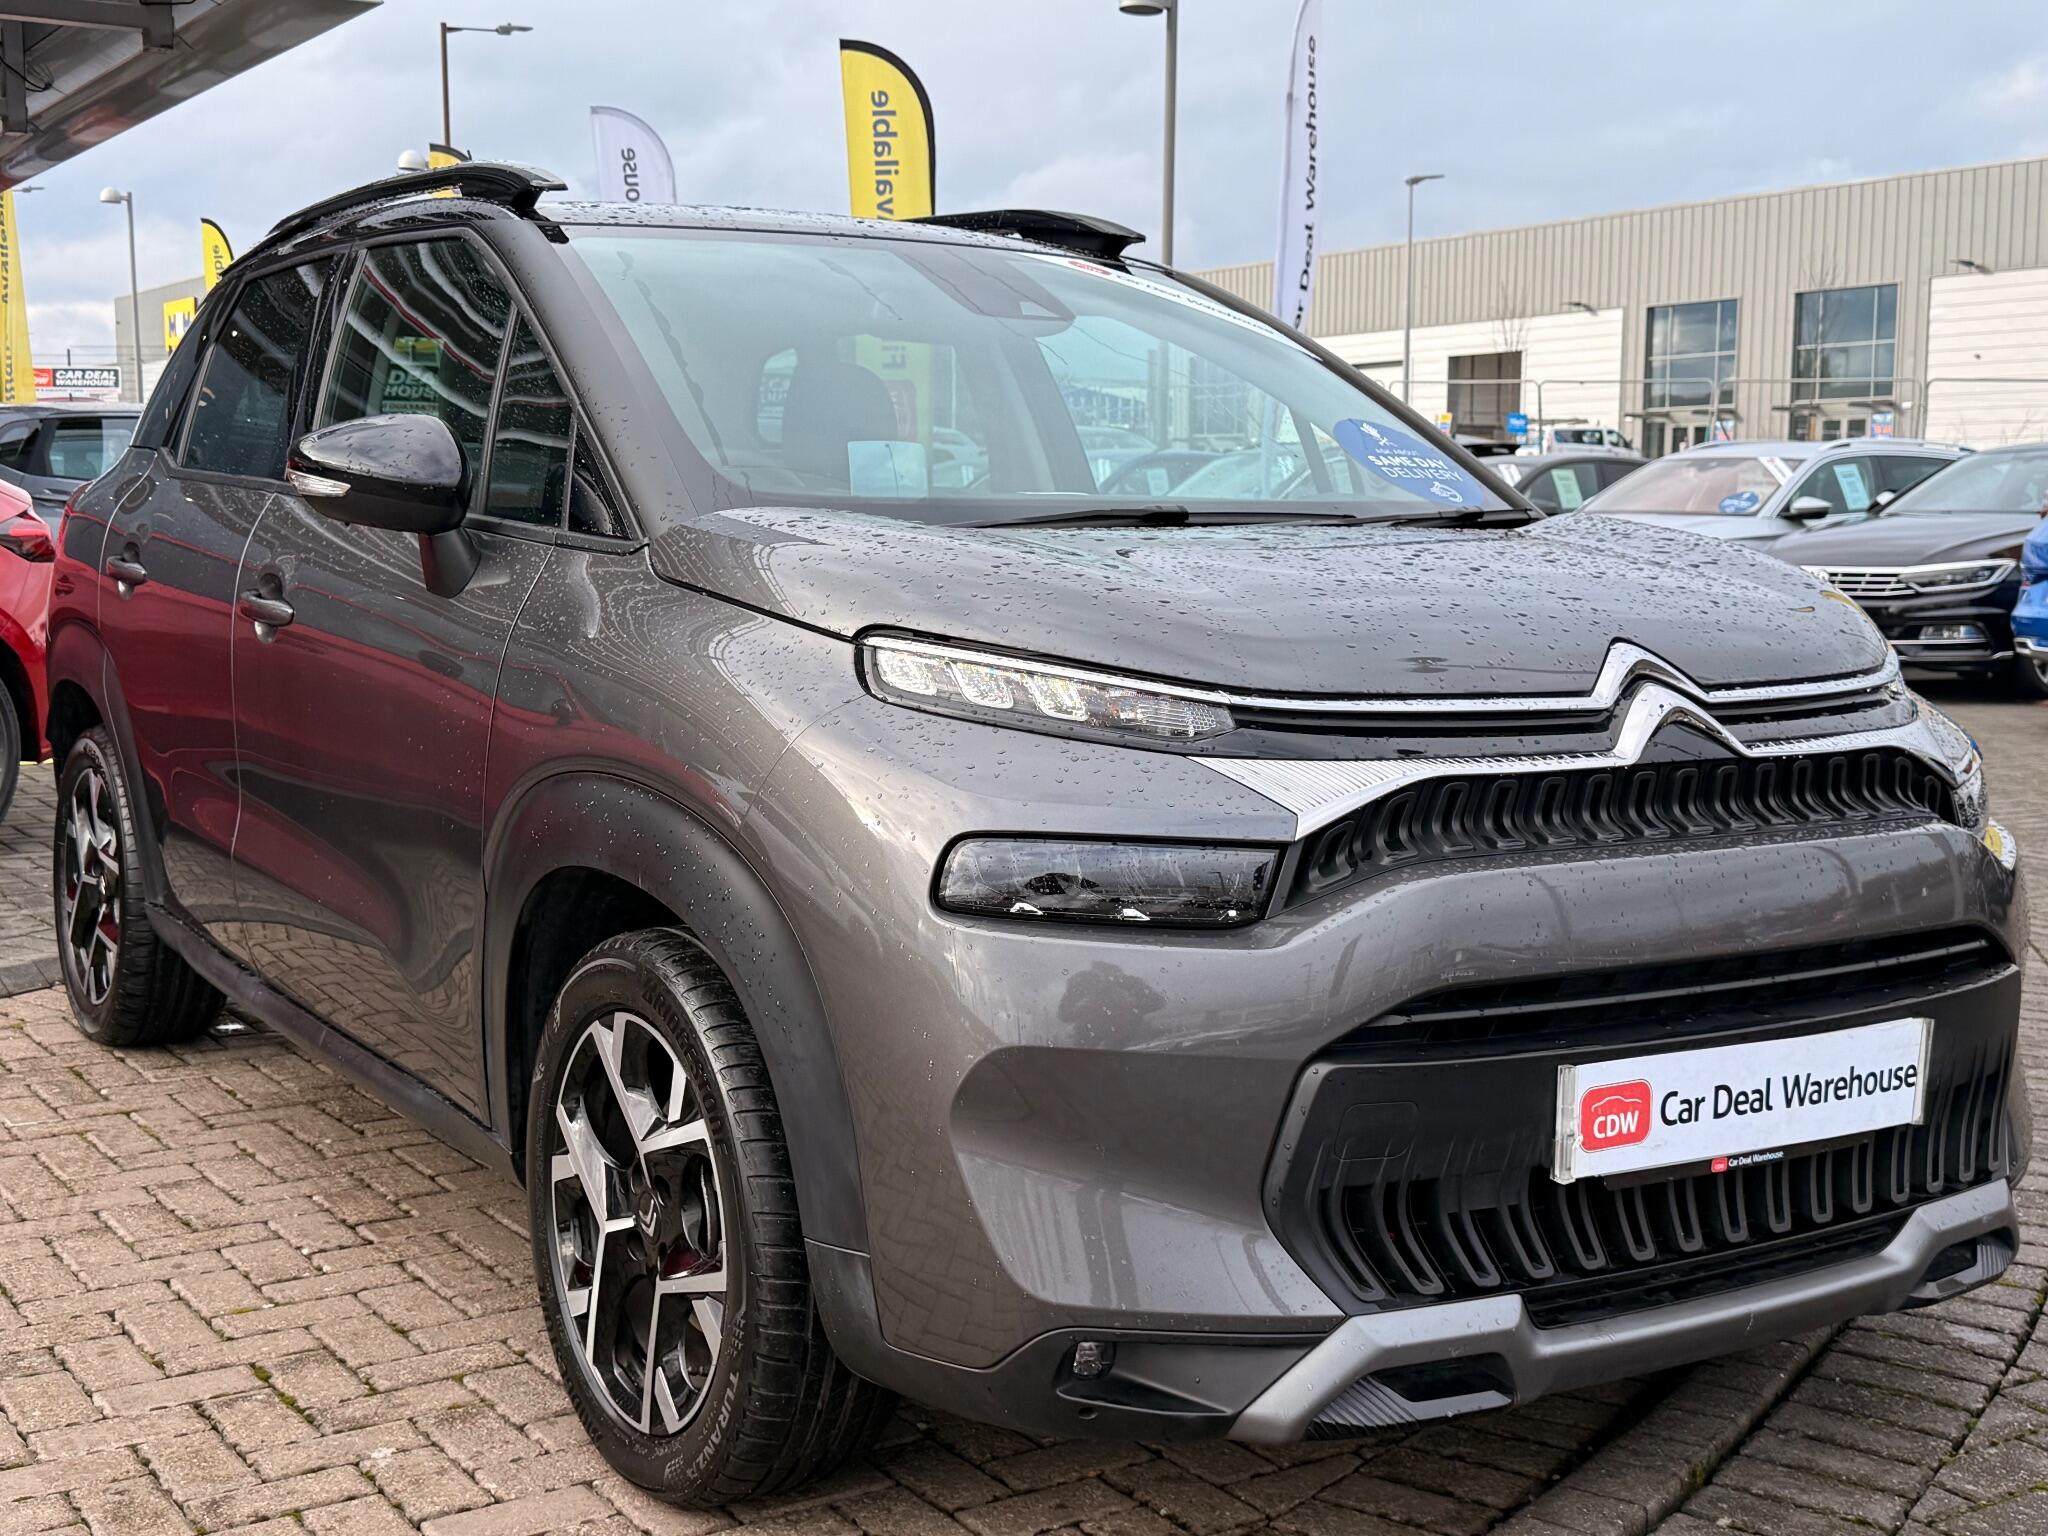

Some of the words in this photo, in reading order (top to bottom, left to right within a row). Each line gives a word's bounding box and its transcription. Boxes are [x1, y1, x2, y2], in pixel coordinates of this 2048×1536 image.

[1305, 34, 1318, 211] Warehouse
[1299, 222, 1314, 293] Deal
[55, 370, 83, 379] CAR
[83, 370, 116, 379] DEAL
[55, 378, 116, 386] WAREHOUSE
[1368, 455, 1416, 467] SAME
[1412, 457, 1449, 470] DAY
[1381, 466, 1464, 482] DELIVERY
[1660, 1090, 1706, 1127] Car
[1712, 1077, 1773, 1120] Deal
[1782, 1063, 1918, 1109] Warehouse
[1592, 1109, 1639, 1139] CDW
[1728, 1157, 1739, 1167] Car
[1739, 1155, 1752, 1166] Deal
[1752, 1150, 1785, 1164] Warehouse
